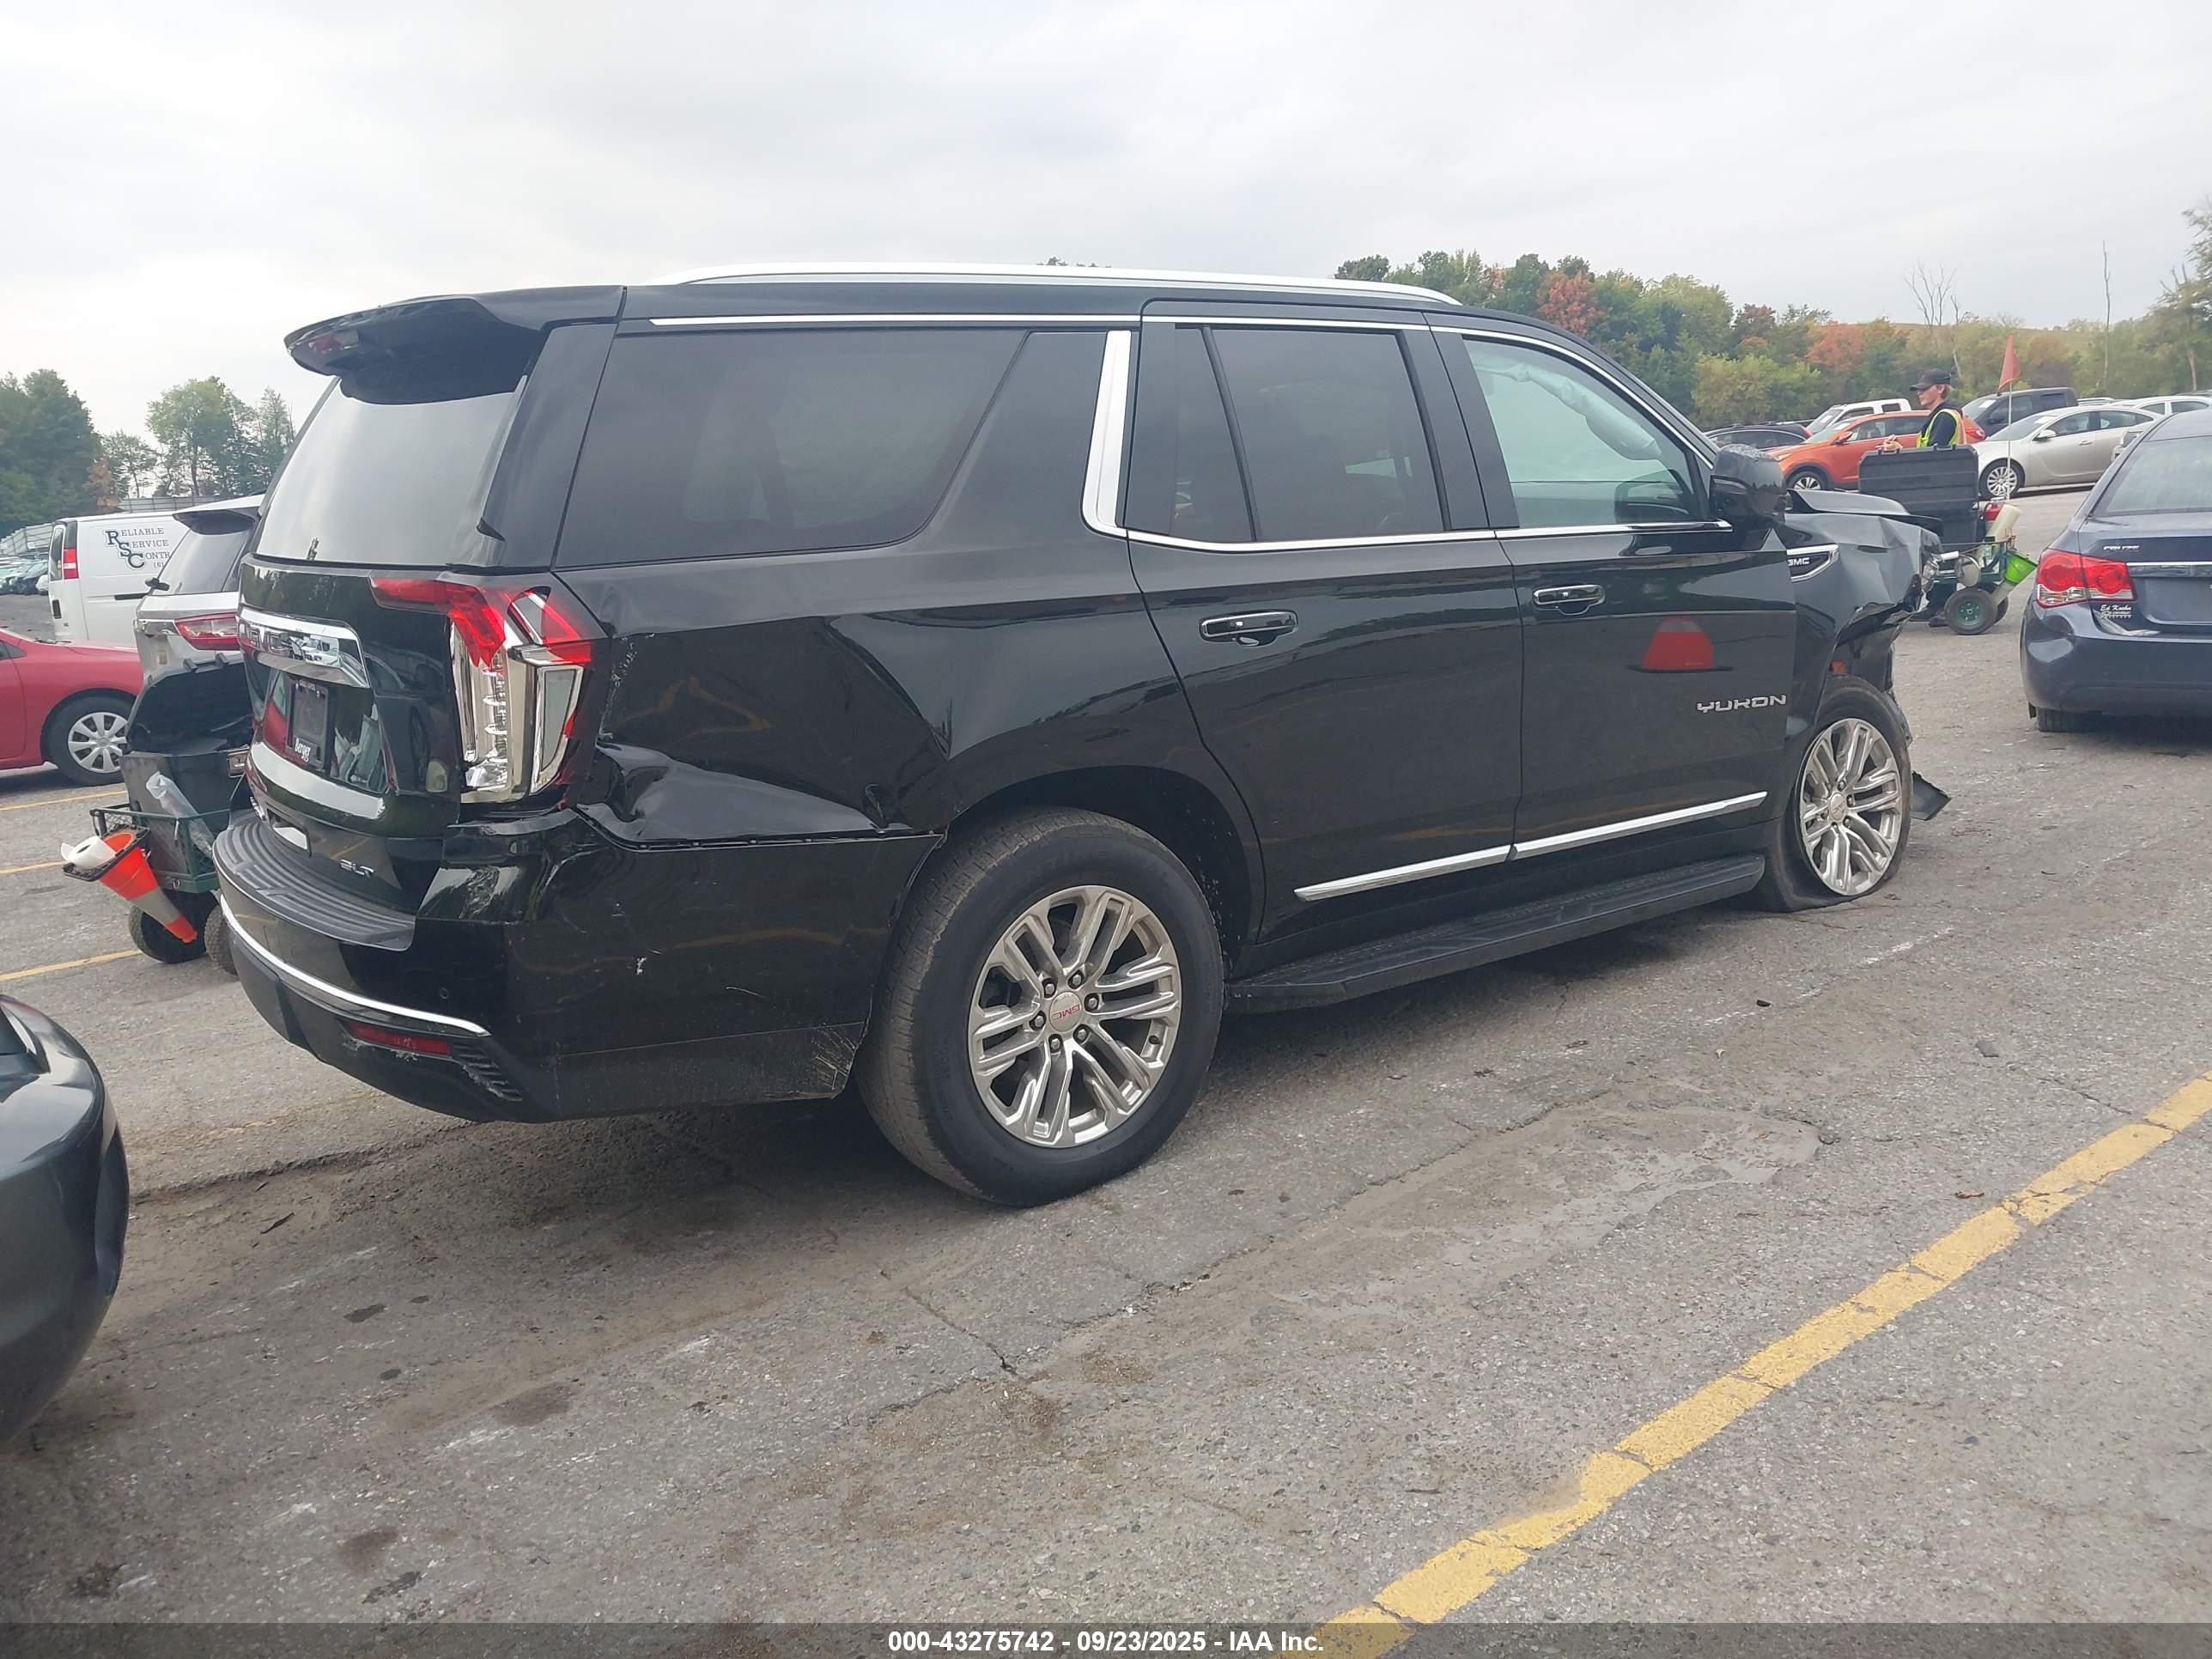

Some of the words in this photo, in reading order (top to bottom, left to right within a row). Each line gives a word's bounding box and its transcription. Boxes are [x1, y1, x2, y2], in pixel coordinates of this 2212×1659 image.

[105, 527, 165, 545] RELIABLE
[119, 539, 170, 557] SERVICE
[1697, 695, 1787, 714] YUKON
[1052, 1004, 1080, 1021] GMC
